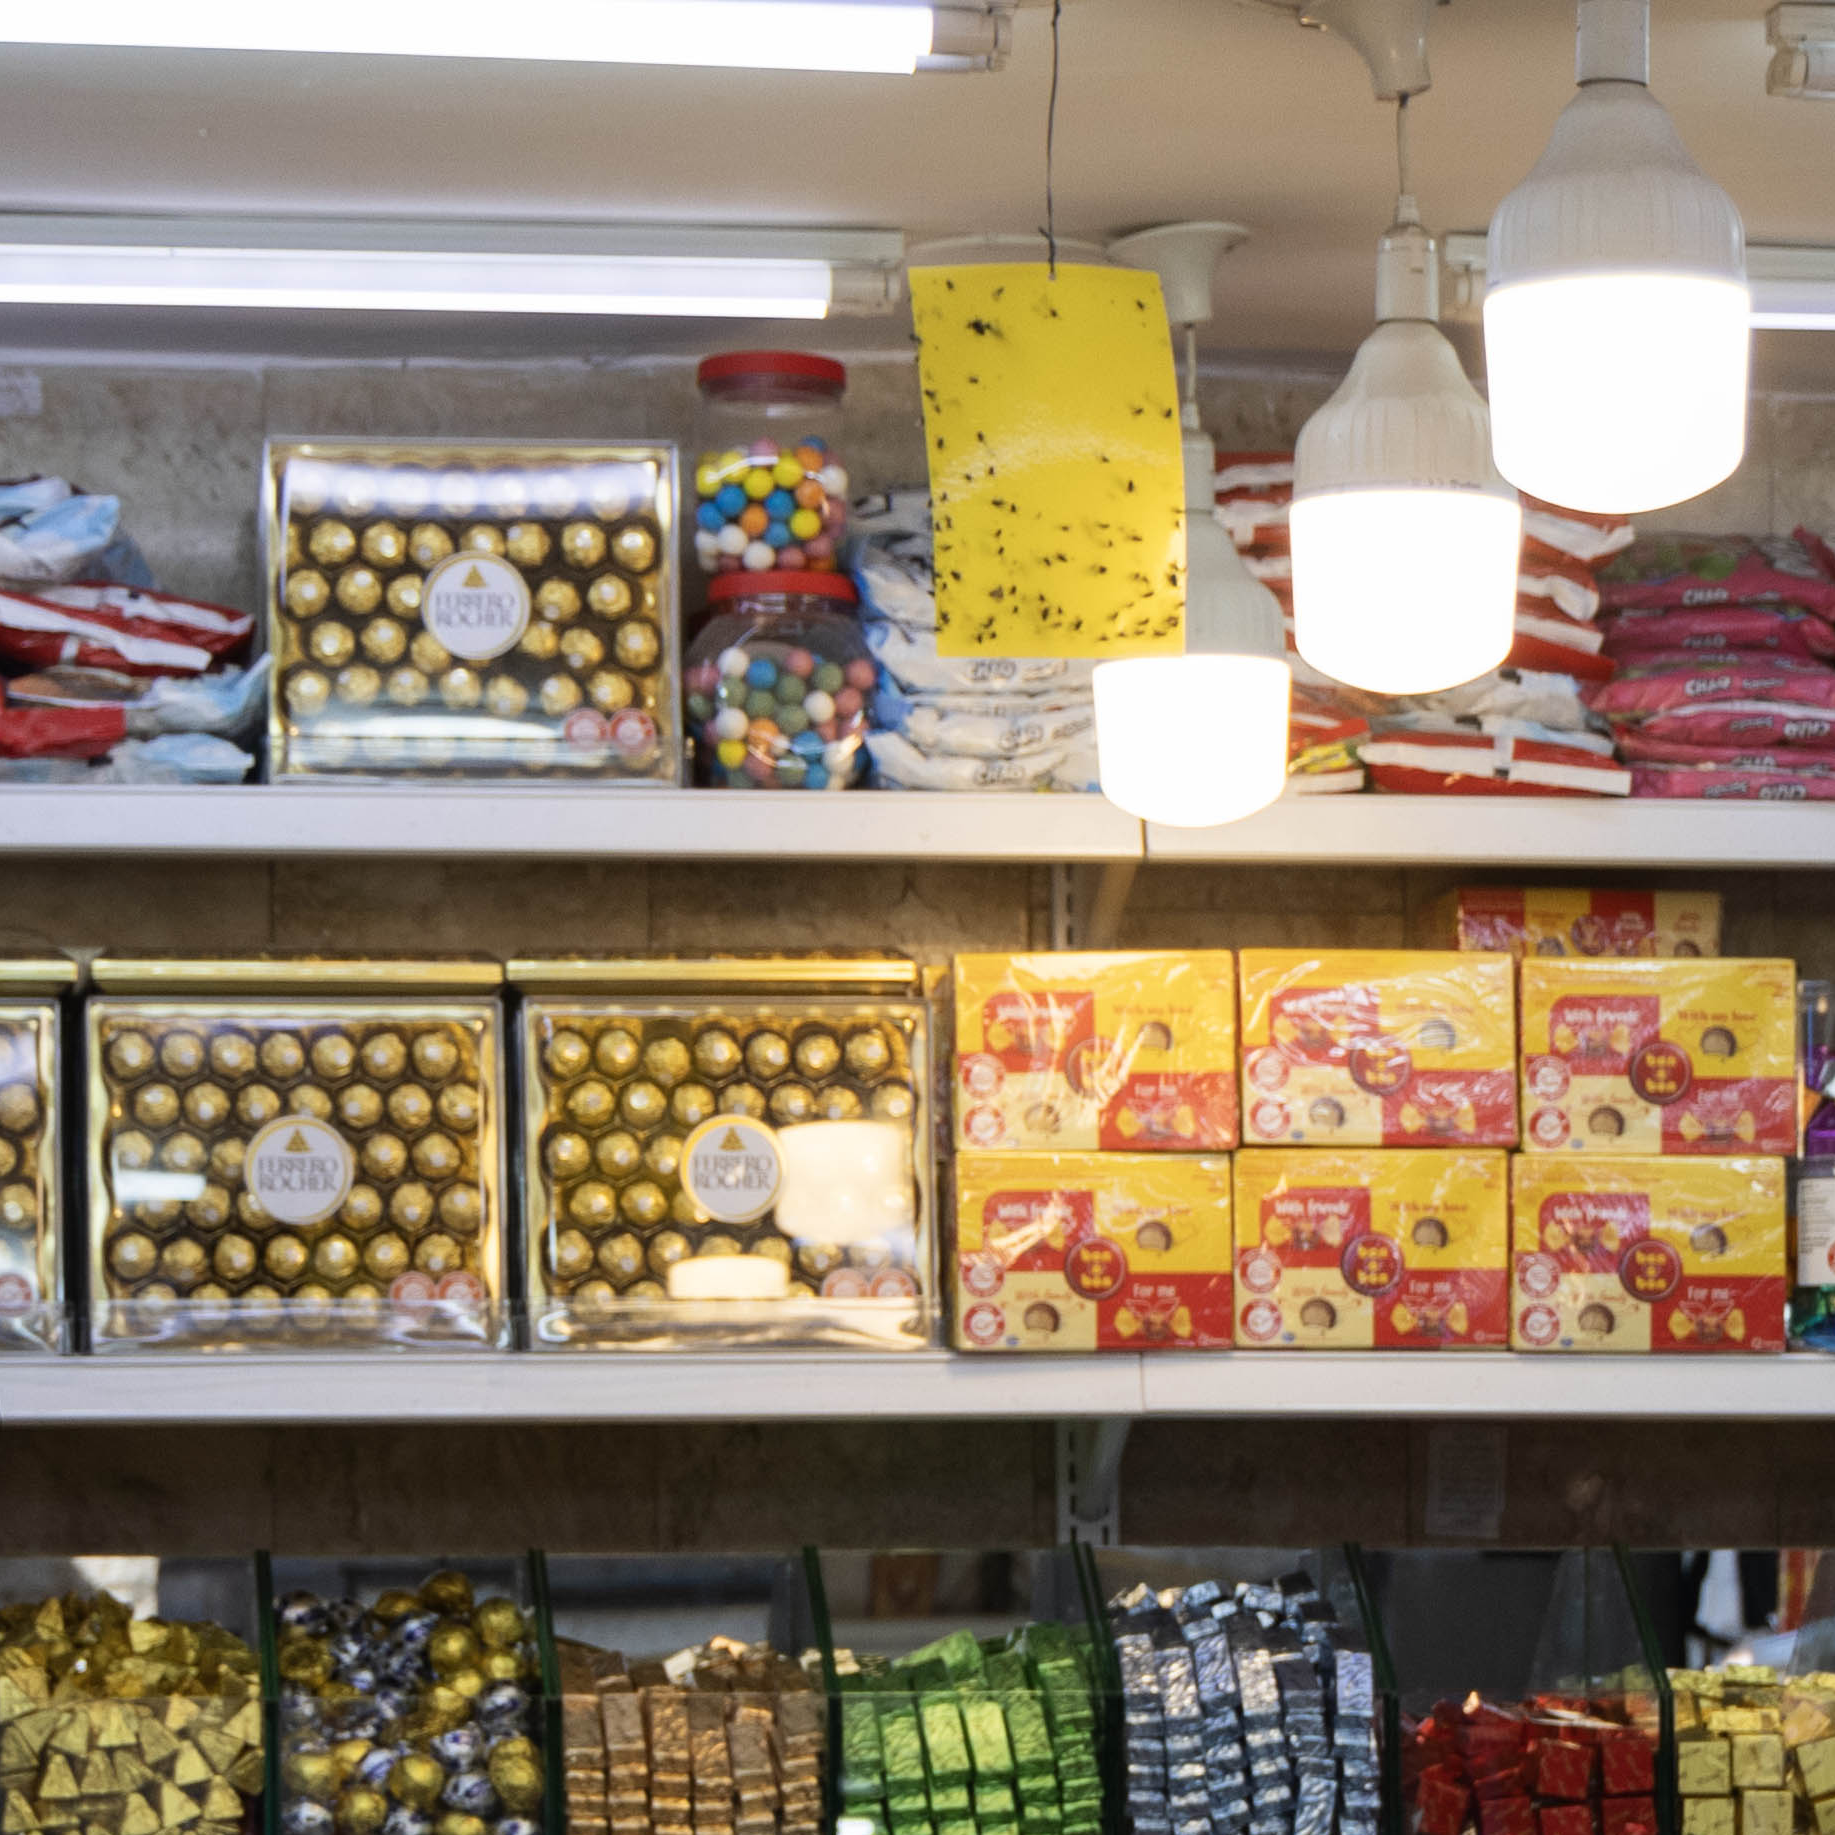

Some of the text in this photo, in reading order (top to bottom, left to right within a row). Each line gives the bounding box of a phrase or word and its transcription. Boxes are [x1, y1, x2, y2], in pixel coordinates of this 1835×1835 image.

[1684, 676, 1732, 696] CHAO
[256, 1158, 342, 1175] FERRERO
[258, 1175, 341, 1193] ROCHER
